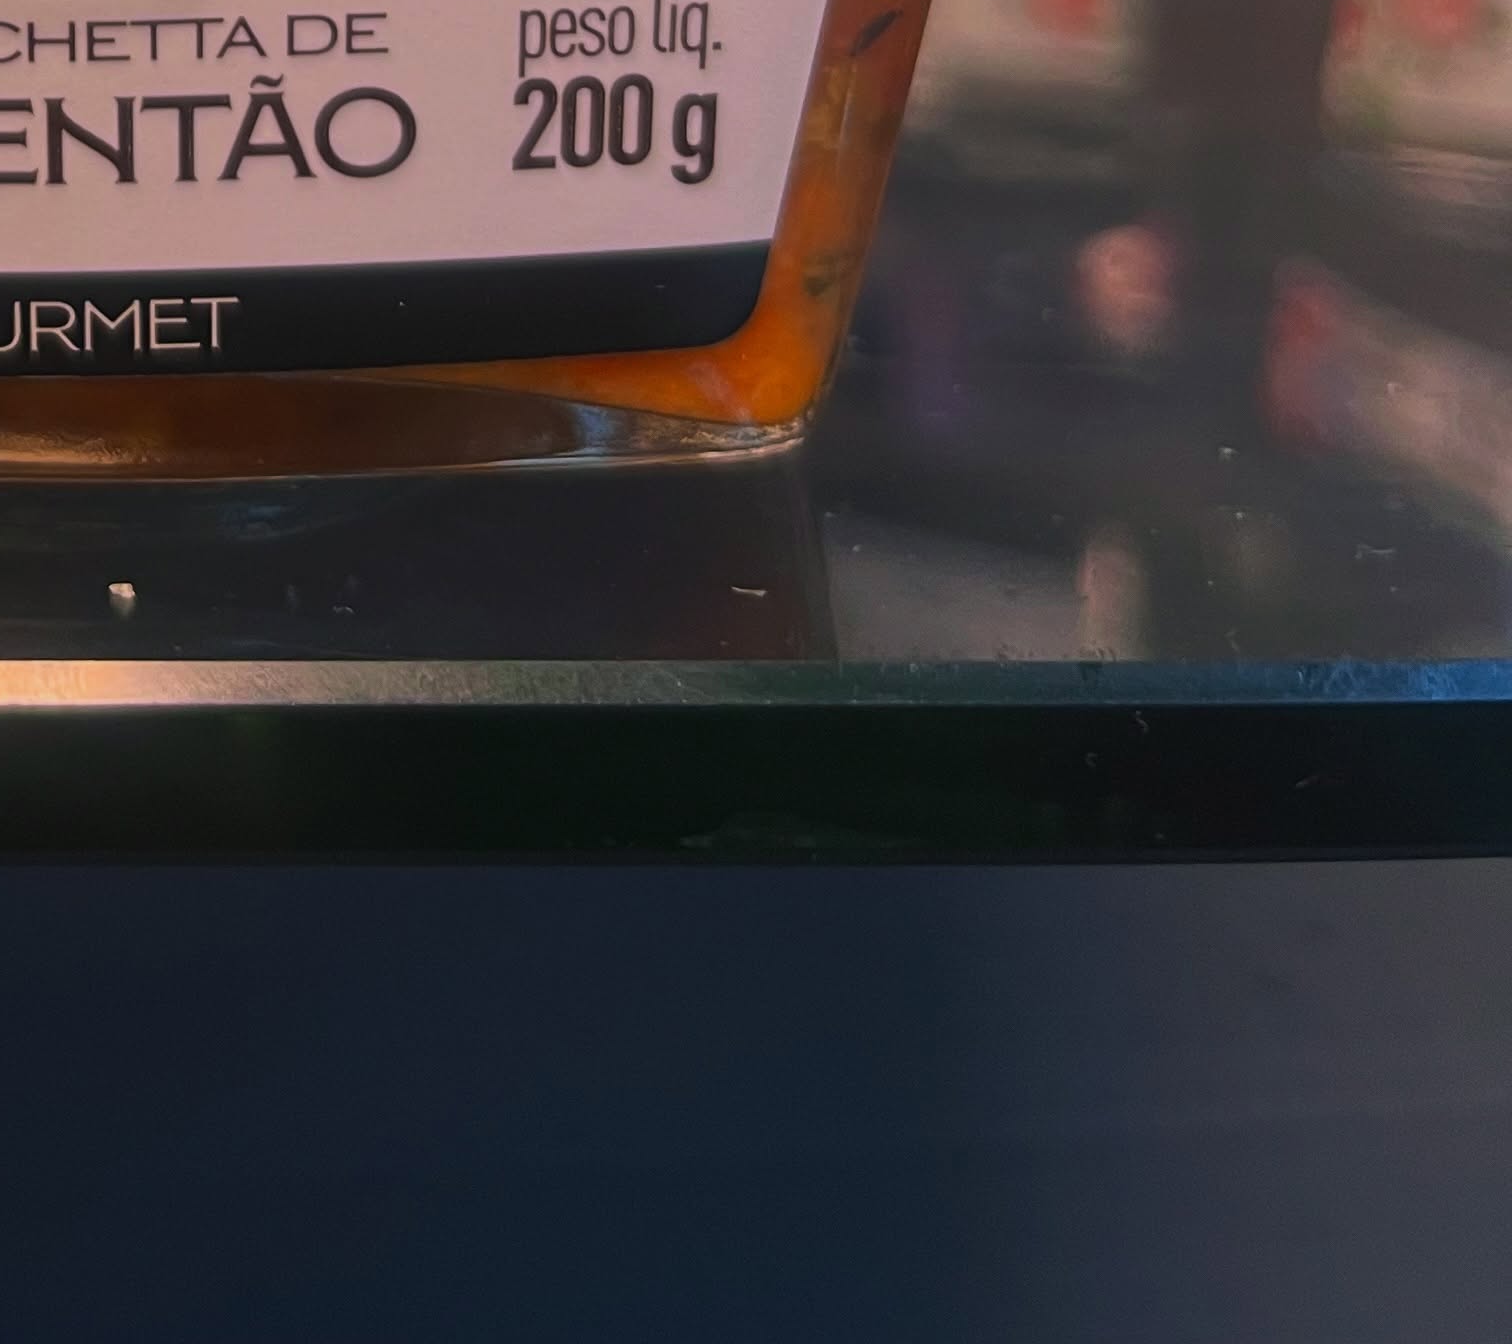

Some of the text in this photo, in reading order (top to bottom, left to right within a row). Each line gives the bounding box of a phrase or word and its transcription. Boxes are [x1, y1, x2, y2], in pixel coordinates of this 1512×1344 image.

[286, 12, 390, 57] DE
[518, 5, 636, 79] peso
[511, 72, 719, 186] 200 g
